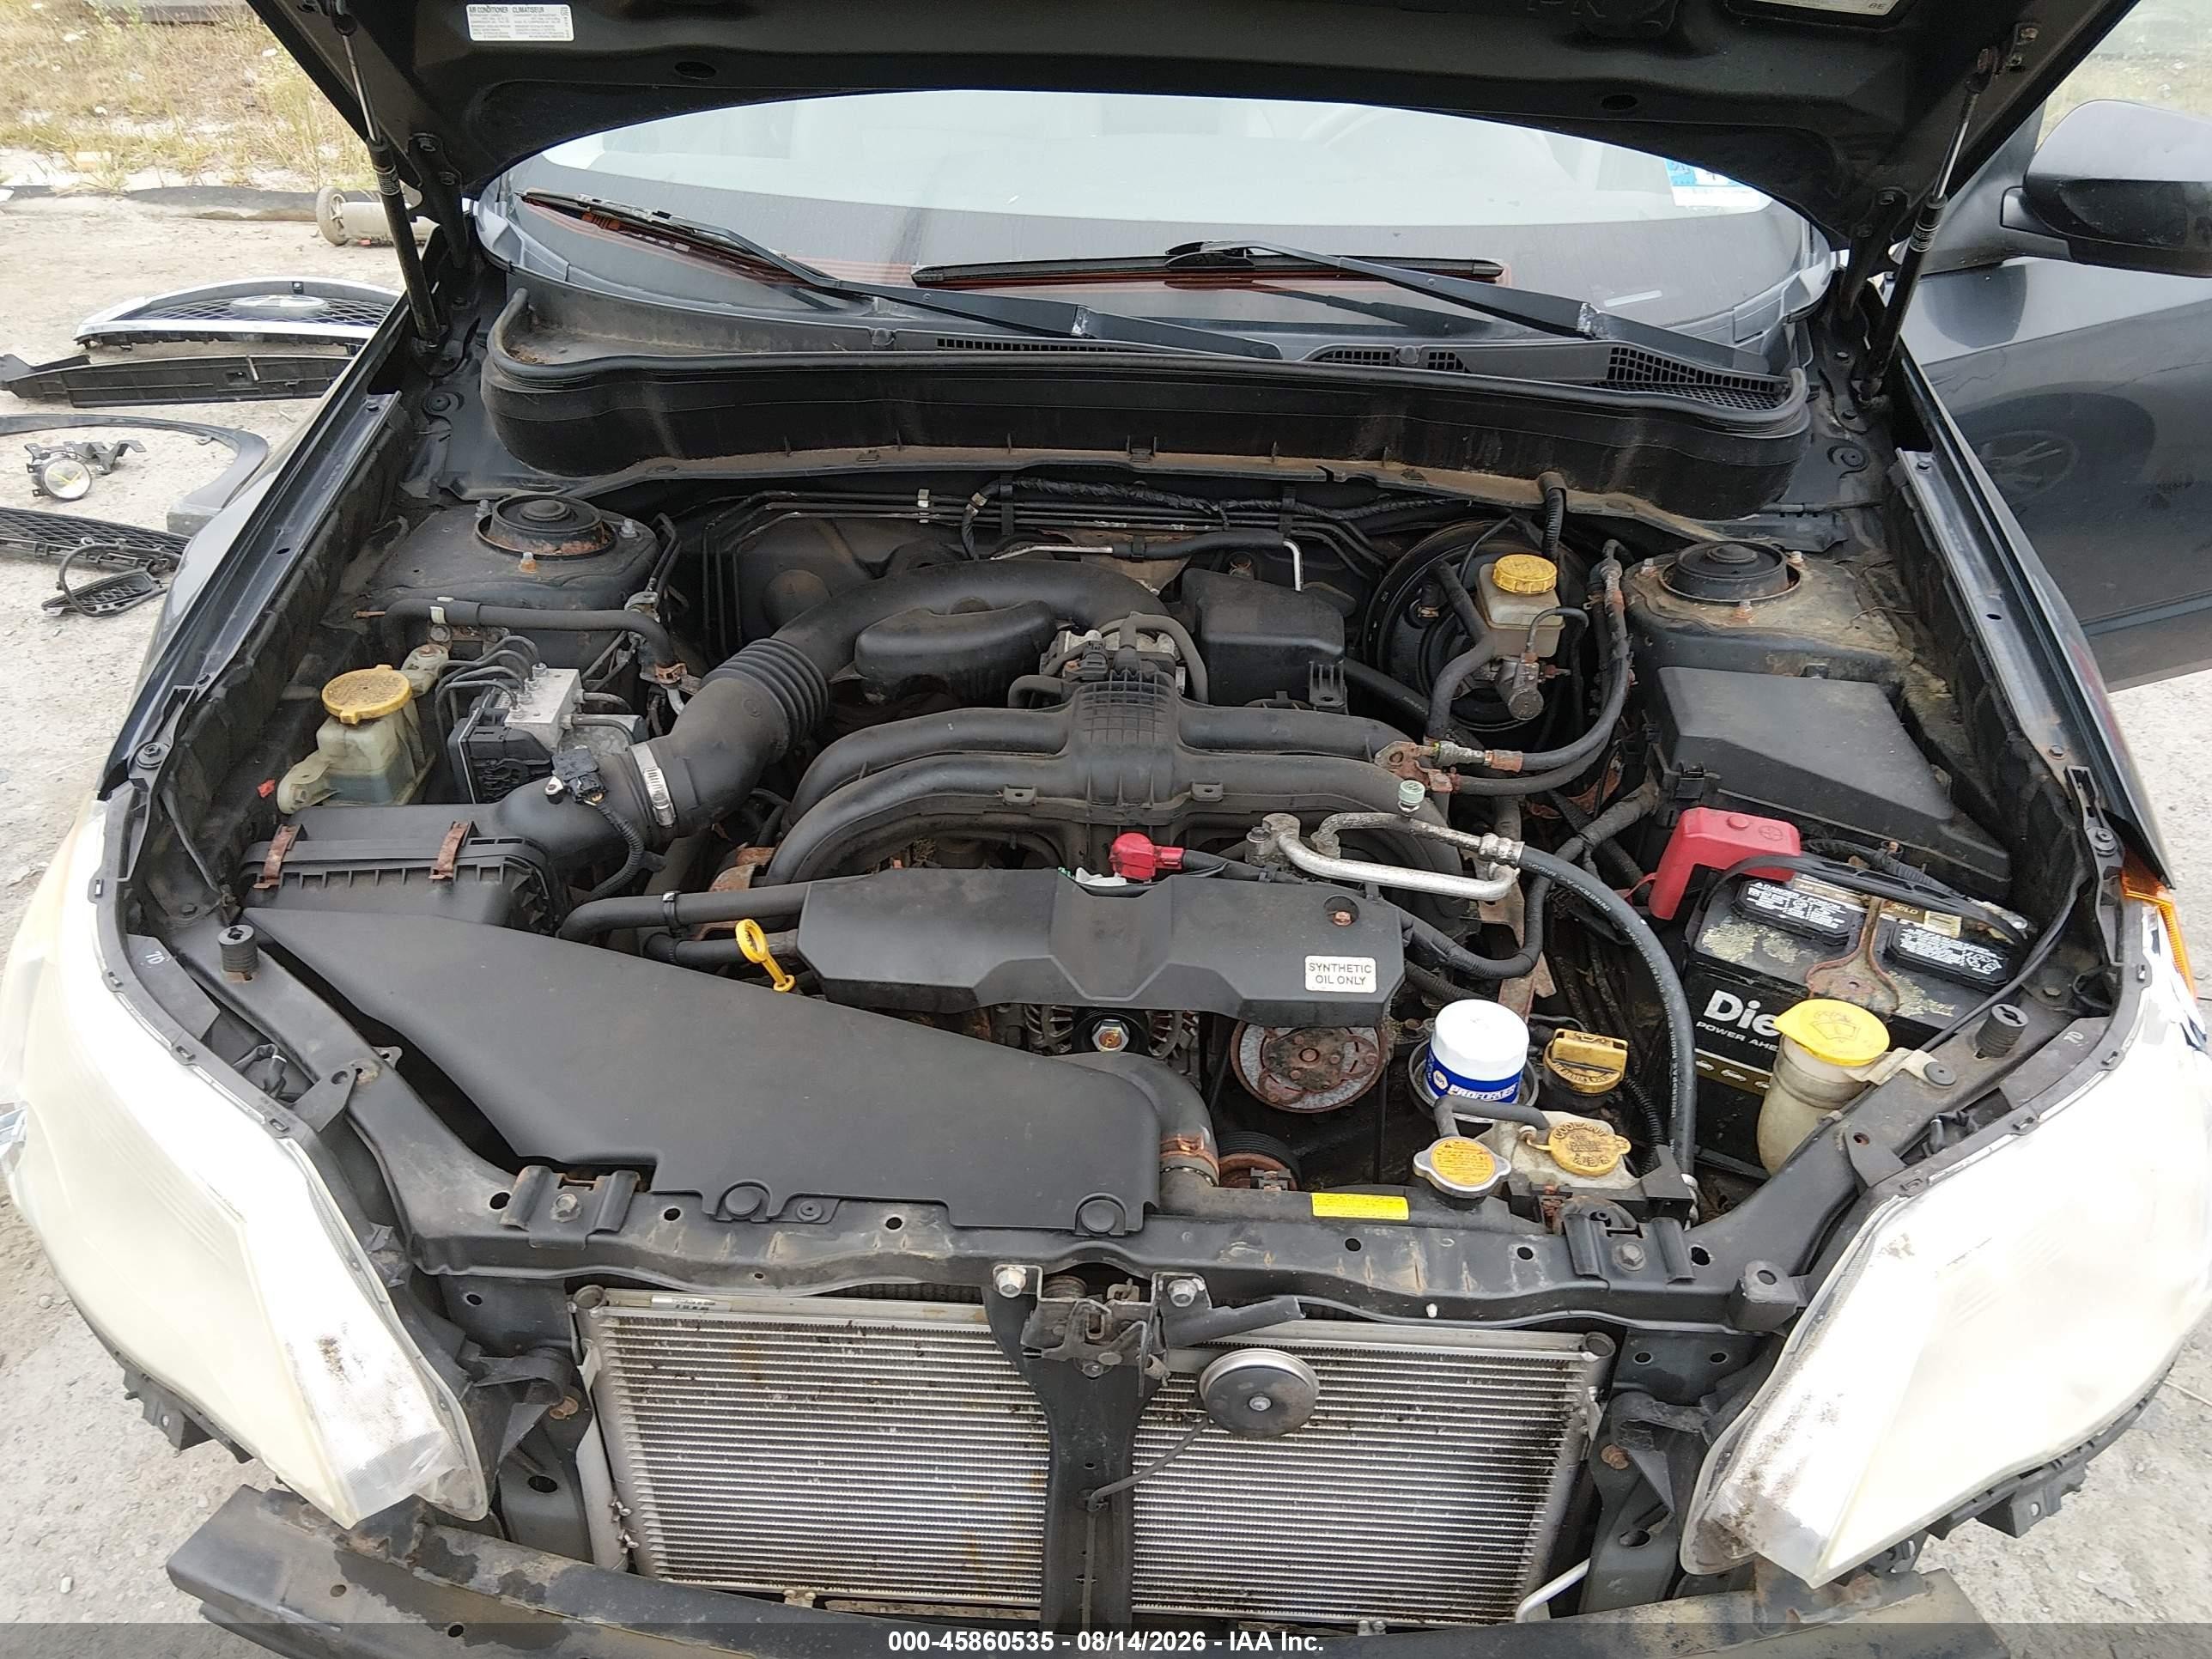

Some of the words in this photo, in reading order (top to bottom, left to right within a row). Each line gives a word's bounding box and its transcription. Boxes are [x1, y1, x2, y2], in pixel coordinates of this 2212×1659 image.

[1308, 962, 1372, 974] SYNTHETIC
[1315, 975, 1334, 985] OIL
[1336, 975, 1366, 986] ONLY
[1695, 1020, 1747, 1042] POWER
[1747, 1037, 1780, 1054] AHE
